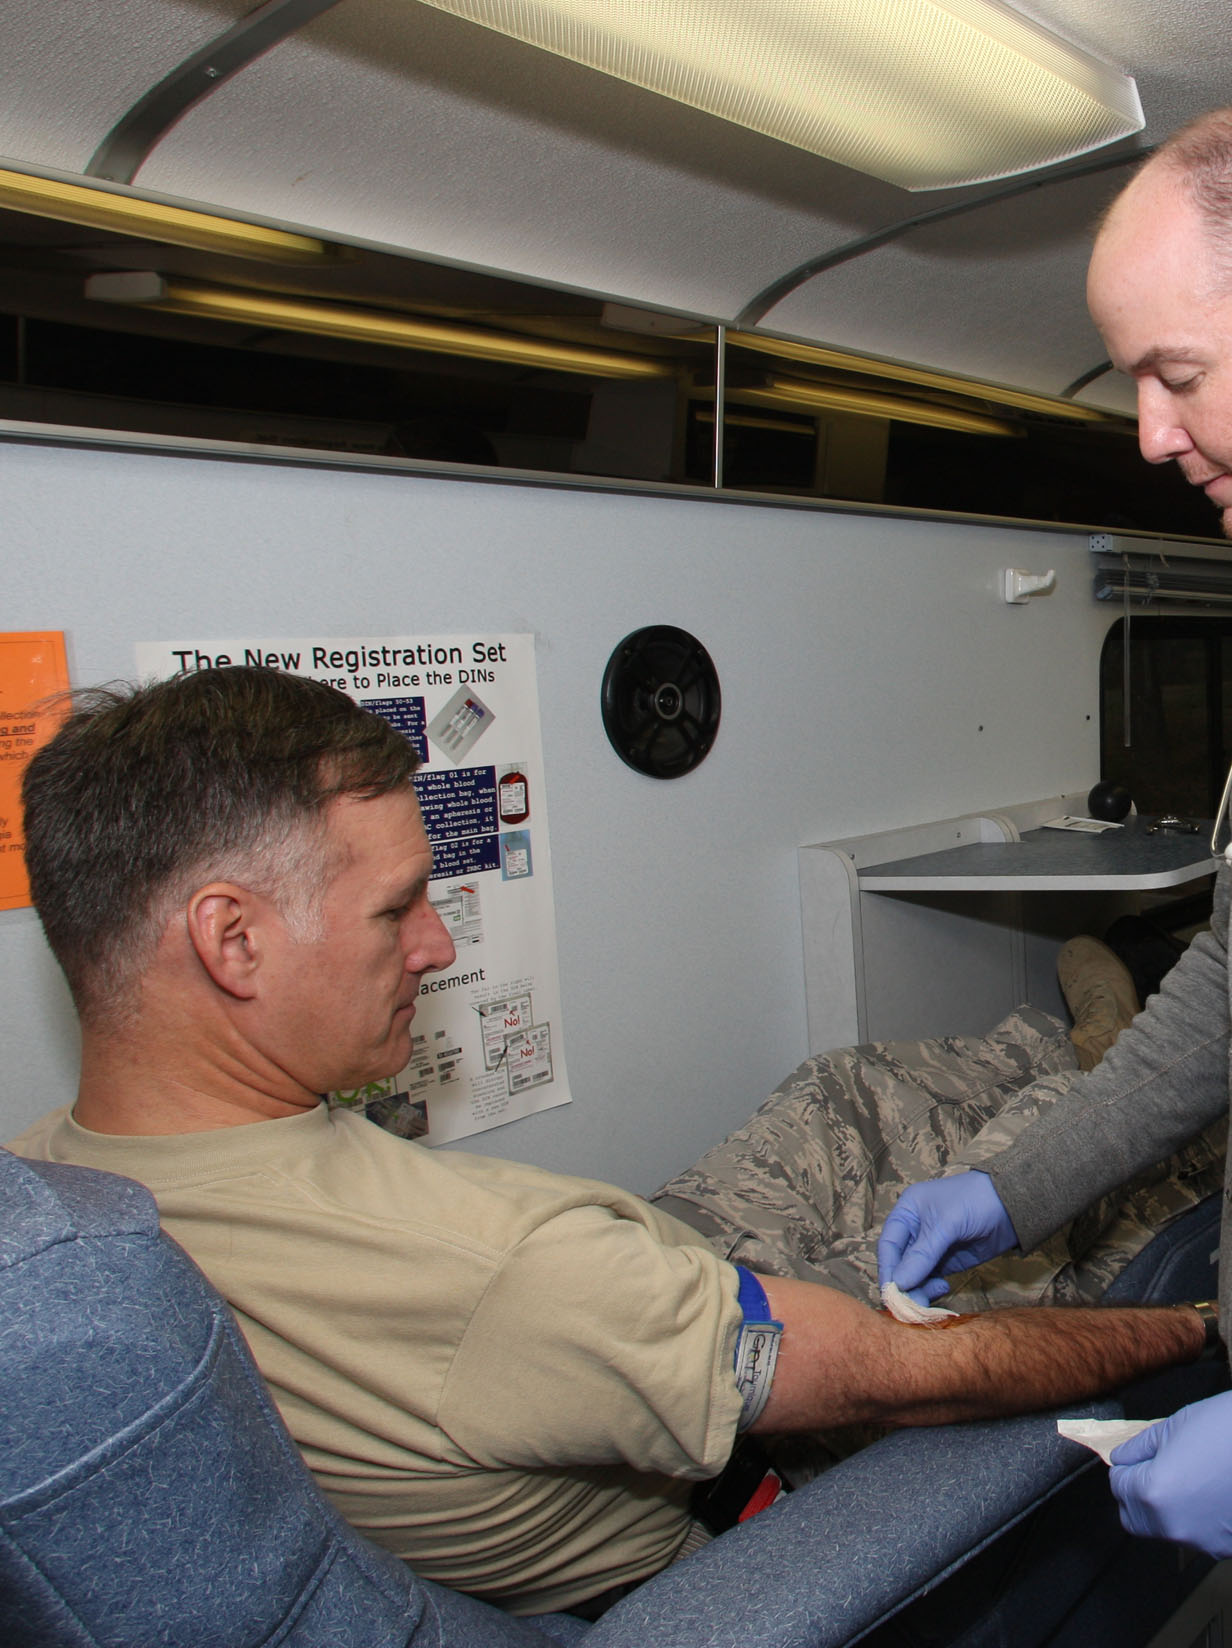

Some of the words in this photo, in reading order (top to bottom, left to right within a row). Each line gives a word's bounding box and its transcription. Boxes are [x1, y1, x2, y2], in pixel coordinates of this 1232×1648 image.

[172, 649, 232, 671] The
[244, 649, 301, 670] New
[312, 644, 462, 673] Registration
[472, 642, 507, 663] Set
[353, 674, 370, 689] to
[377, 672, 420, 688] Place
[426, 671, 453, 685] the
[458, 669, 496, 684] DINs
[12, 722, 35, 733] and
[427, 782, 450, 791] whole
[417, 791, 456, 802] llection
[421, 803, 443, 811] awing
[447, 800, 468, 808] whole
[428, 832, 441, 840] for
[446, 830, 458, 838] the
[462, 827, 478, 835] main
[440, 860, 460, 869] blood
[418, 968, 486, 996] acement
[504, 1016, 521, 1028] No!
[520, 1046, 535, 1059] No!
